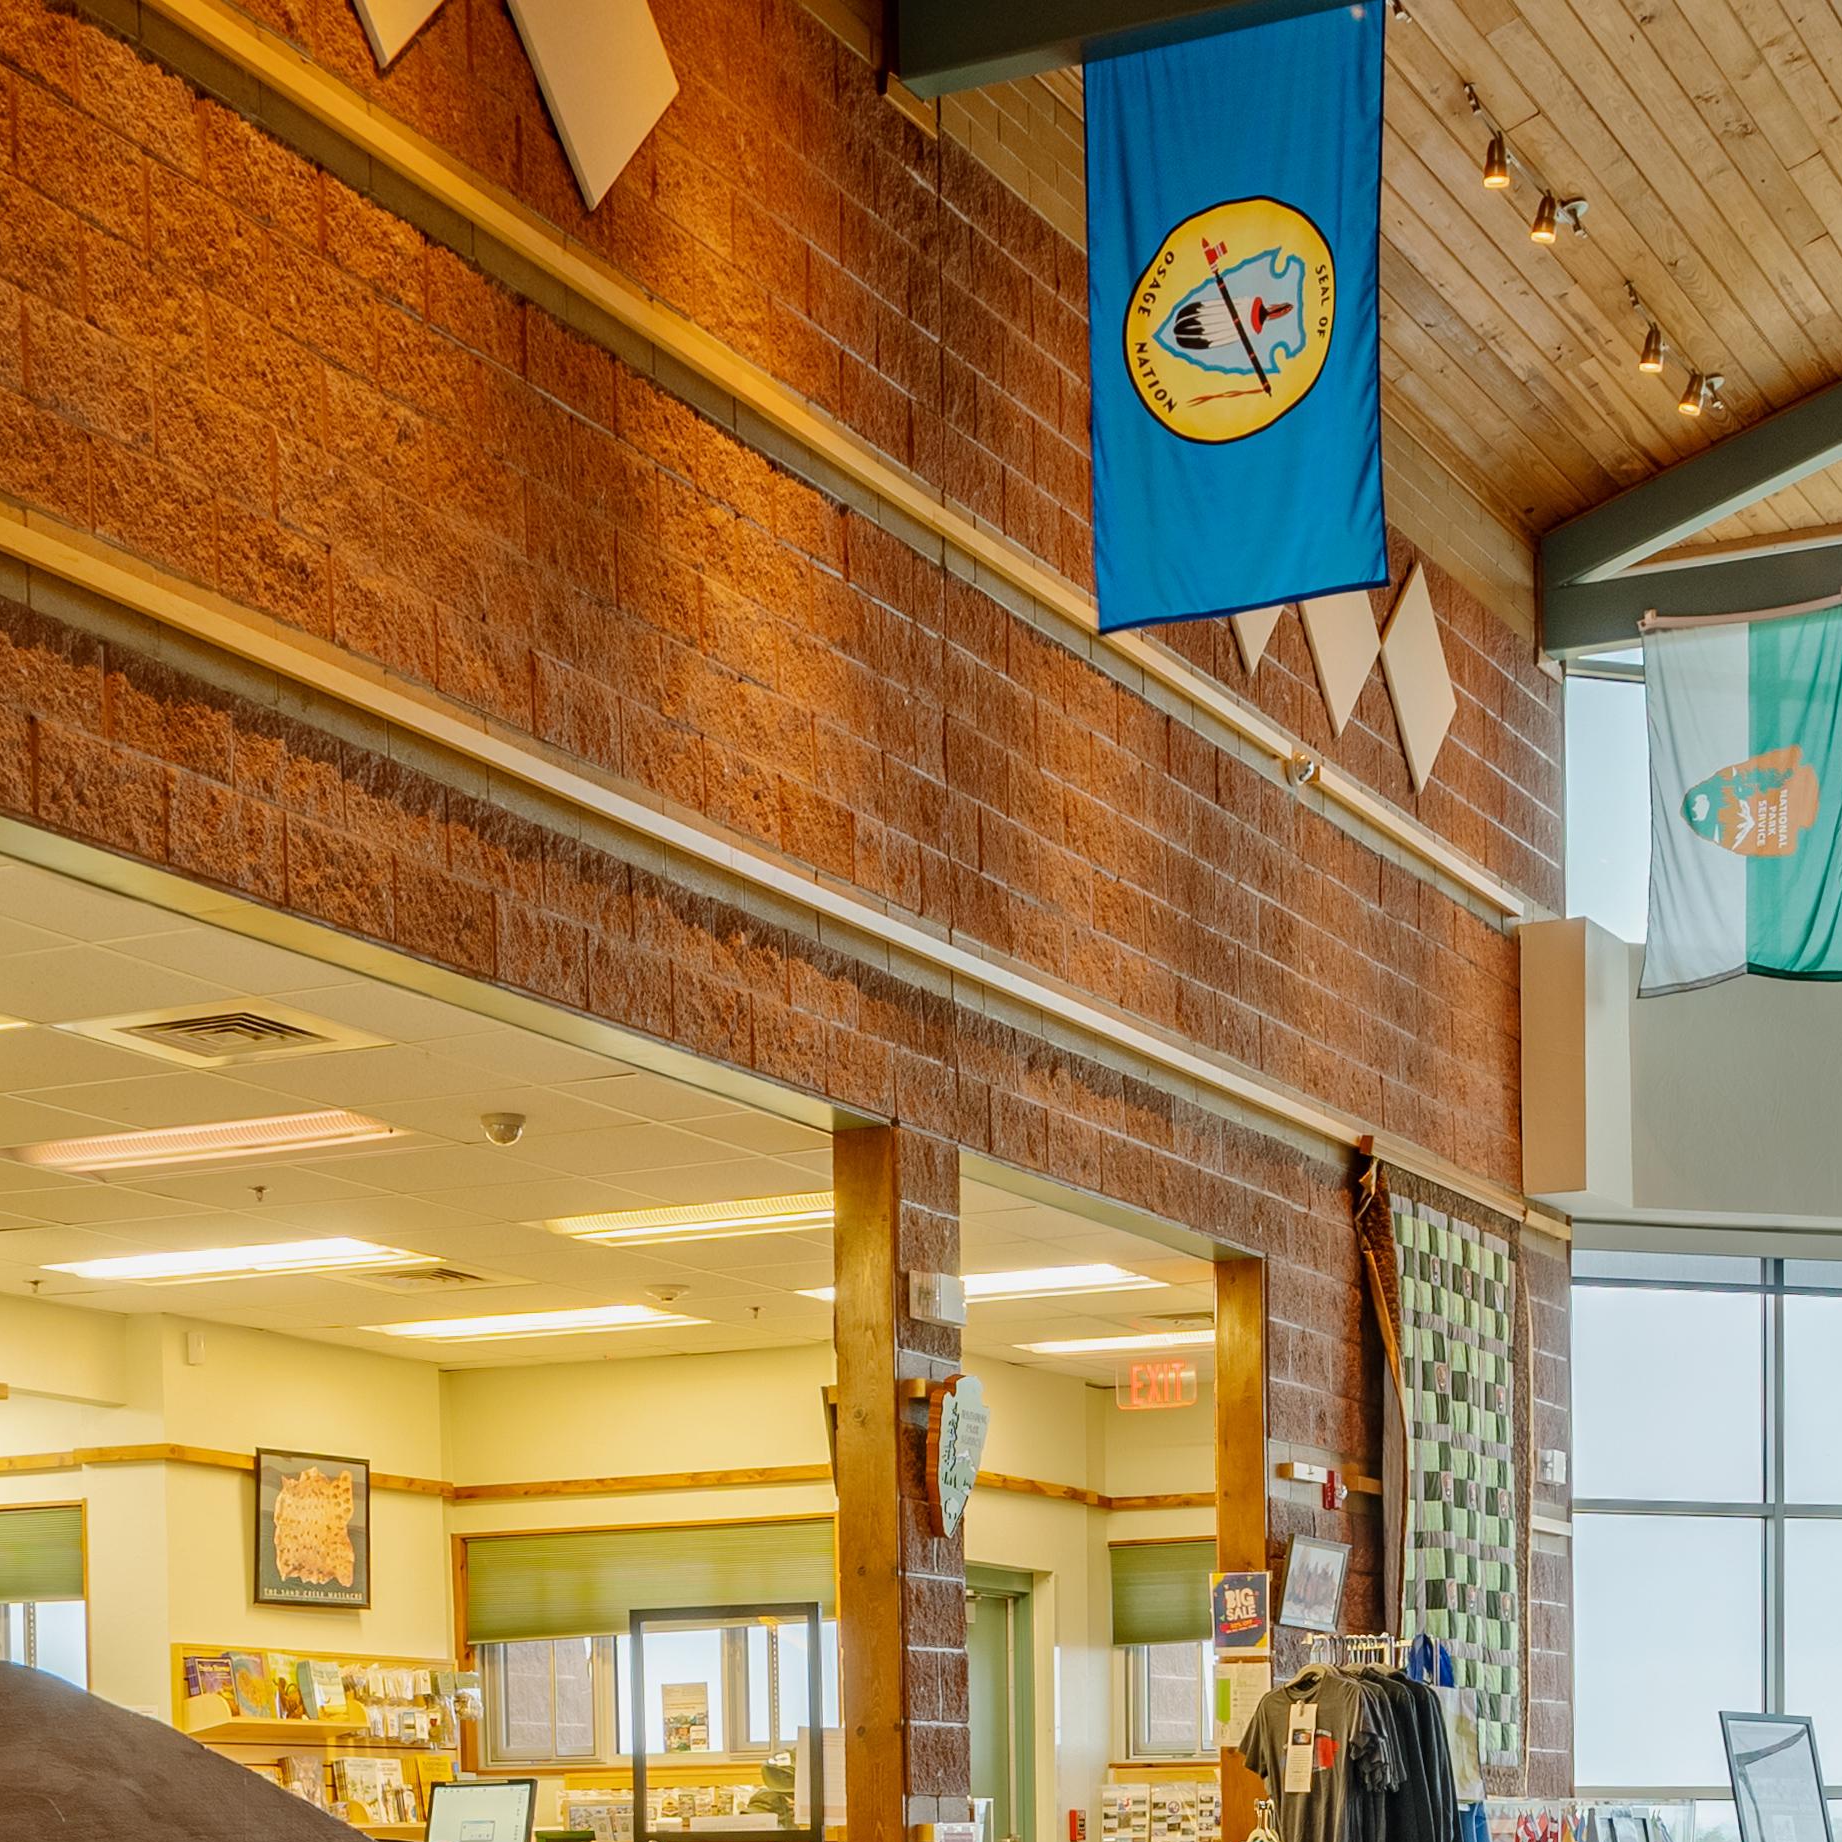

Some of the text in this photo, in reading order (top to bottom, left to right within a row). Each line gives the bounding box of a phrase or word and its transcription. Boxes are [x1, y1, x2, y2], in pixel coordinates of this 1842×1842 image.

[1137, 250, 1175, 317] OSAGE
[1315, 263, 1330, 339] SEAL OF
[1134, 341, 1178, 414] NATION
[1757, 799, 1767, 847] SERVICE
[1767, 804, 1777, 837] PARK
[1778, 788, 1788, 849] NATIONAL
[1130, 1360, 1185, 1405] EXIT
[264, 1587, 277, 1596] THE
[1225, 1588, 1254, 1608] BIG
[1226, 1605, 1257, 1621] SALE
